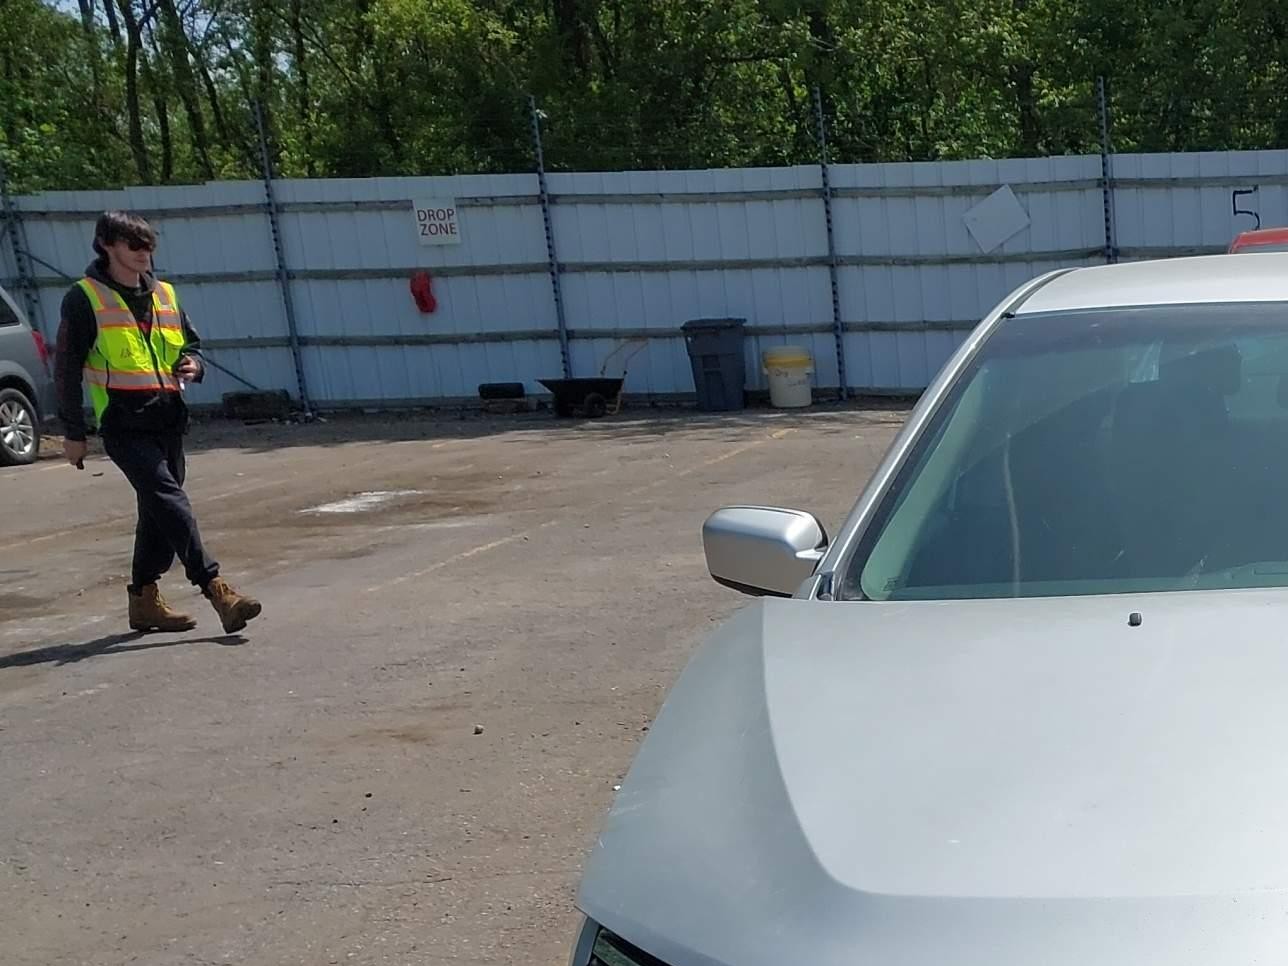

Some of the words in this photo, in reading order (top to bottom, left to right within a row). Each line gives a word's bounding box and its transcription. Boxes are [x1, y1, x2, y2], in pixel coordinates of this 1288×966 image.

[1232, 184, 1261, 231] 5
[417, 208, 455, 221] DROP
[420, 223, 457, 236] ZONE
